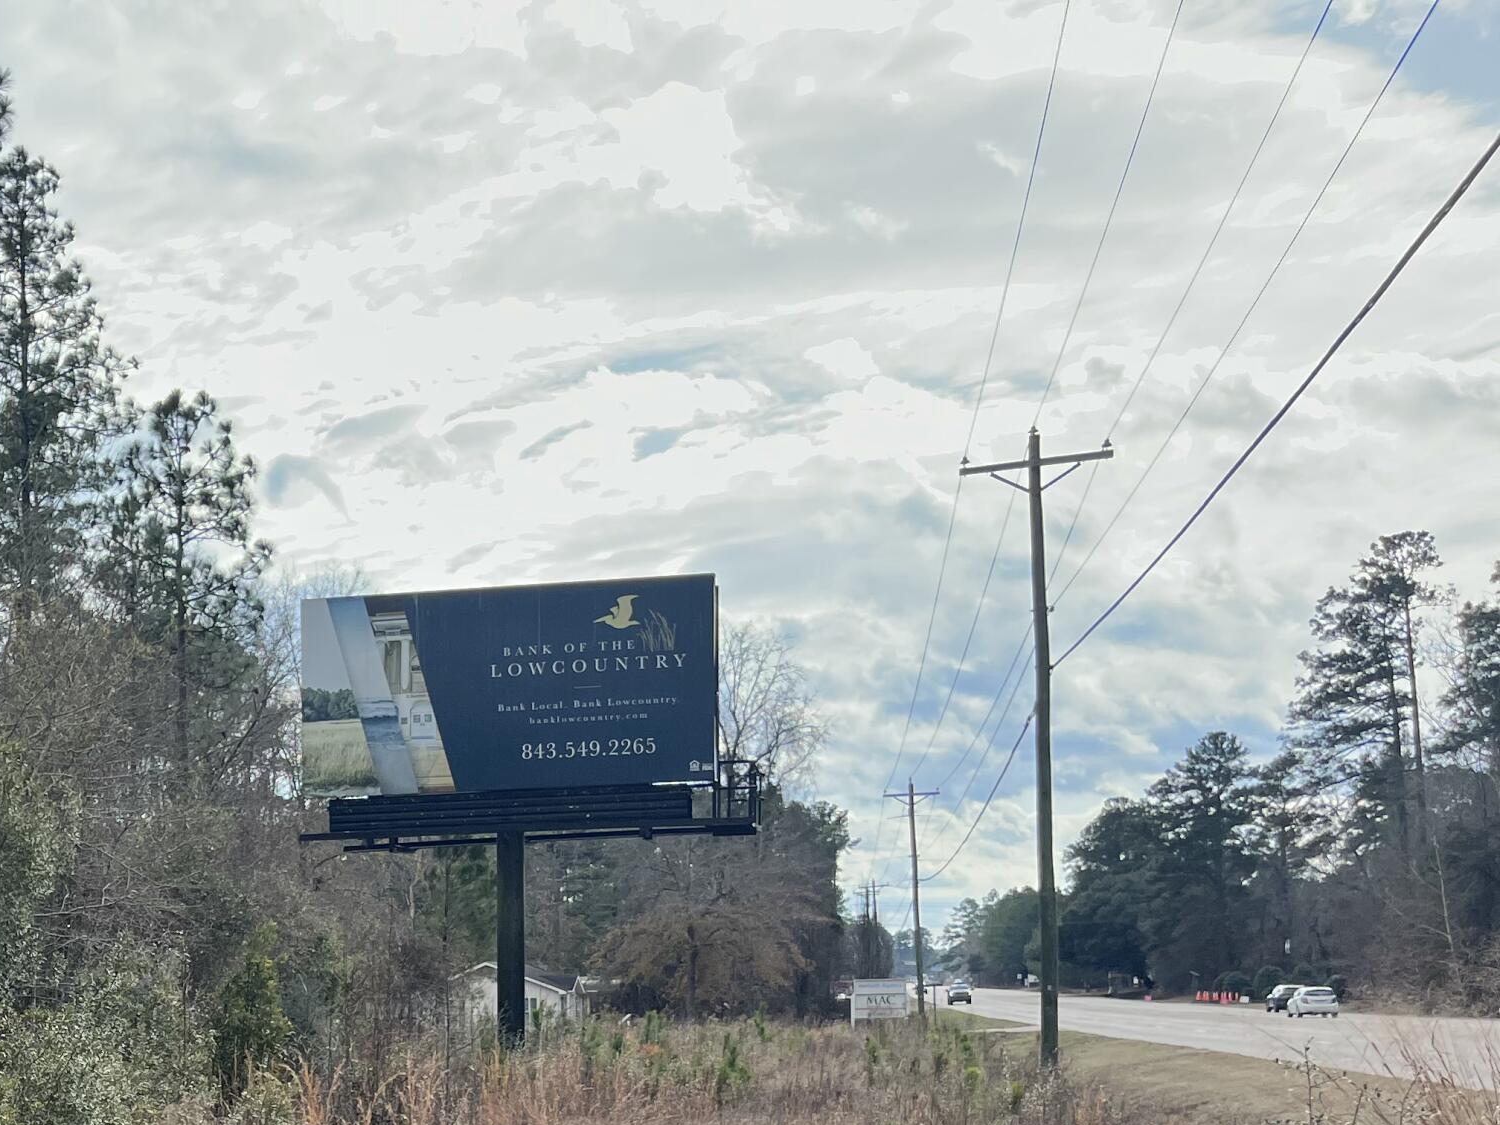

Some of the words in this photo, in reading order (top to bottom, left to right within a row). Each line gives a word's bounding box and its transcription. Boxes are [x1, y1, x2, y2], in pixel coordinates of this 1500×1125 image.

[503, 644, 553, 657] BANK
[564, 642, 588, 654] OF
[599, 639, 636, 652] THE
[491, 653, 687, 678] LOWCOUNTRY
[497, 702, 526, 713] Bank
[531, 700, 568, 711] Local.
[574, 698, 602, 709] Bank
[607, 696, 679, 707] Lowcountry.
[529, 712, 648, 725] banklowcountry.com
[521, 737, 657, 760] 843.549.2265
